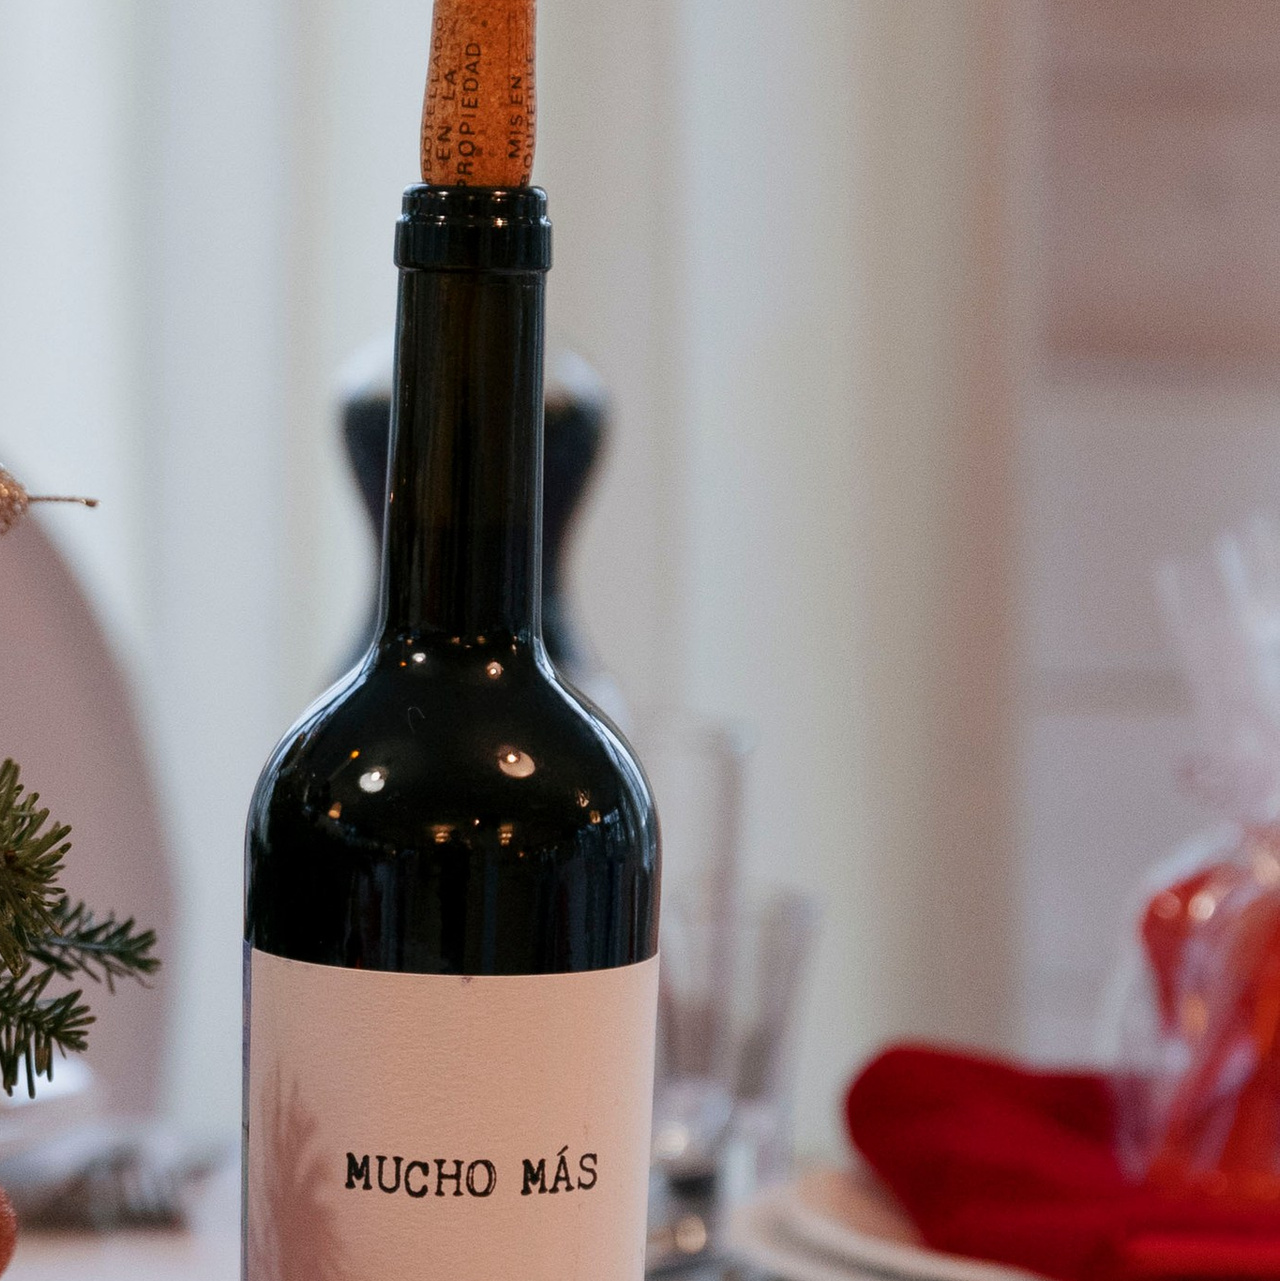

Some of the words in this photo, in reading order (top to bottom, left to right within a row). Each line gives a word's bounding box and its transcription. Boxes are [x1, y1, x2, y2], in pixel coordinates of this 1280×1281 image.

[442, 69, 458, 101] LA
[509, 76, 523, 105] EN
[436, 125, 453, 161] EN
[508, 115, 523, 159] MIS
[345, 1151, 498, 1198] MUCHO
[521, 1145, 598, 1195] MÁS
